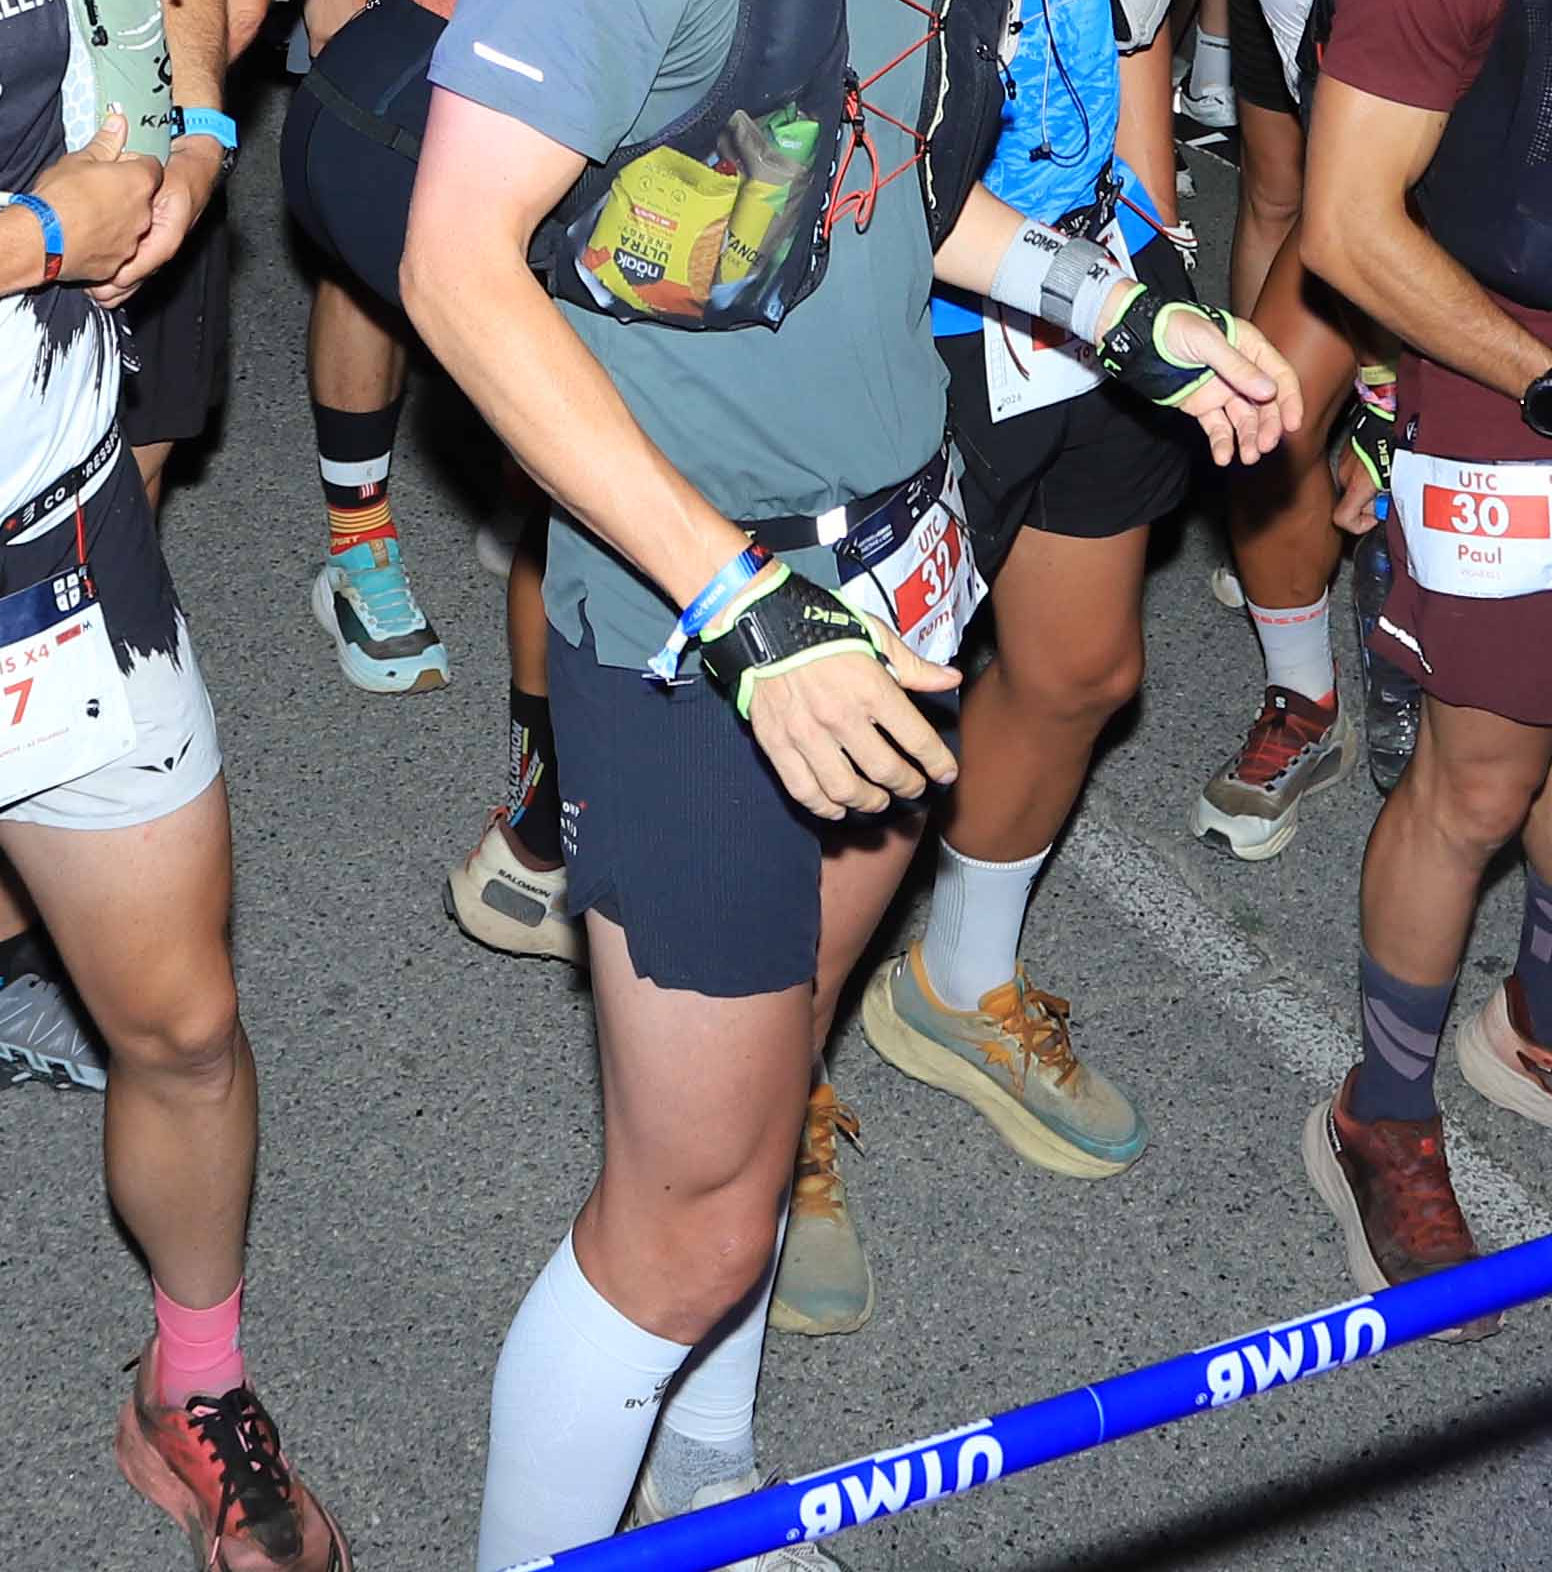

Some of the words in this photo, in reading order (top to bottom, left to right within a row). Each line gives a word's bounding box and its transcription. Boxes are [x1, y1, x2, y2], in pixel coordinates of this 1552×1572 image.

[620, 234, 670, 262] ULTRA
[1457, 470, 1498, 491] UTC
[917, 514, 943, 556] UTC
[1449, 496, 1510, 538] 30
[1457, 543, 1503, 565] Paul
[921, 539, 952, 609] 32
[23, 646, 50, 667] X4
[497, 868, 552, 899] SALOMON
[1206, 1307, 1387, 1408] UTMB
[800, 1433, 1005, 1541] UTMB
